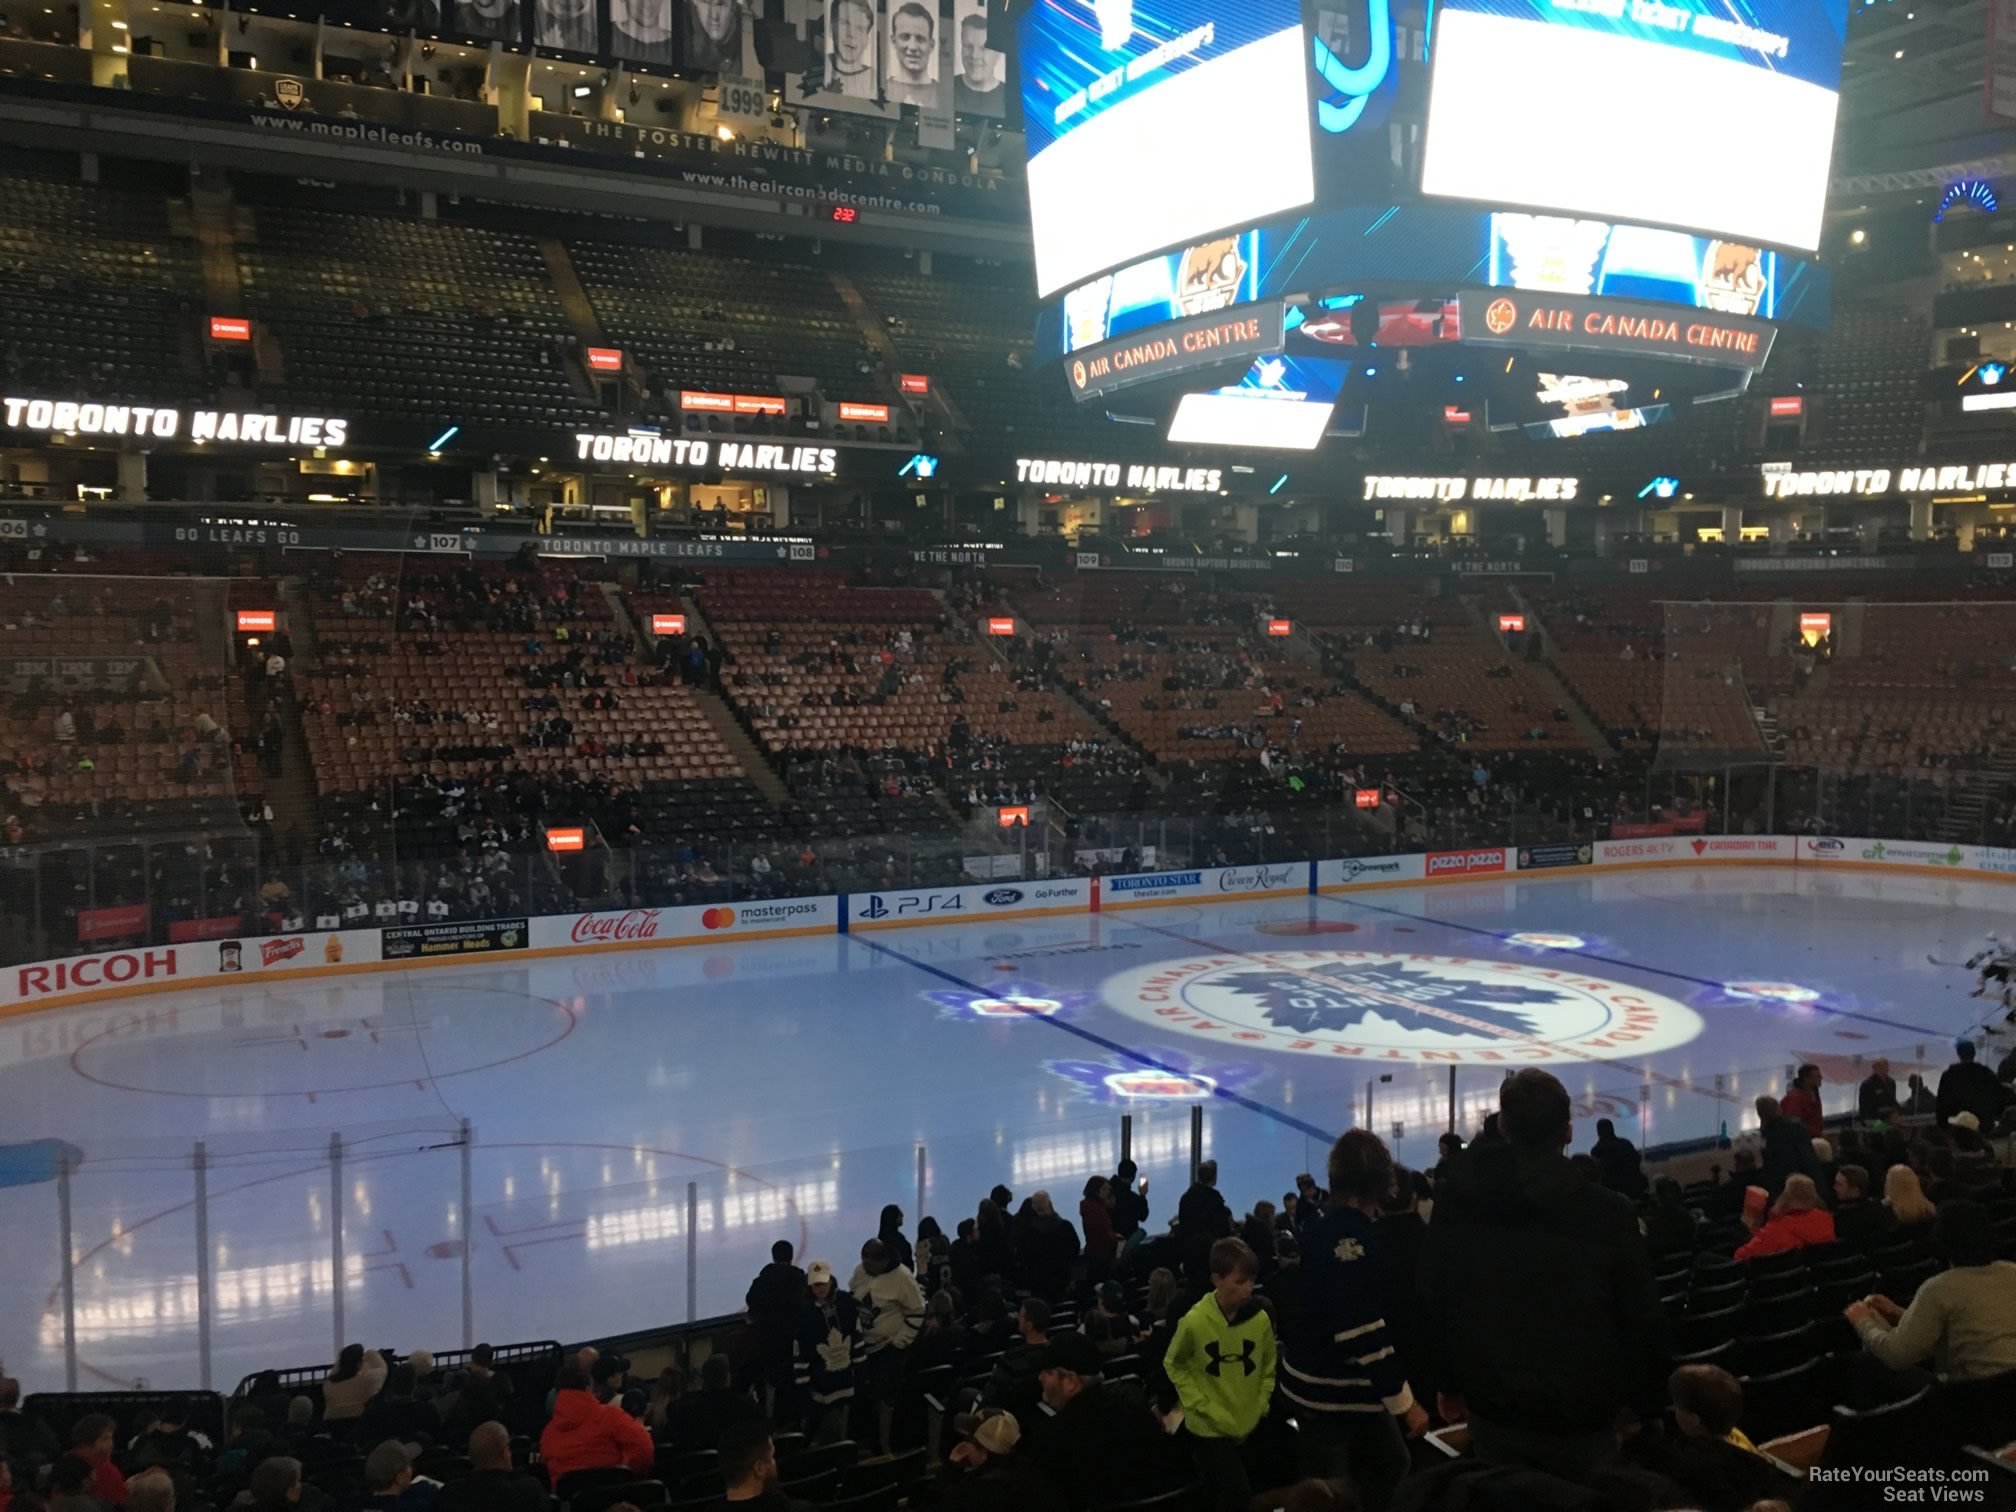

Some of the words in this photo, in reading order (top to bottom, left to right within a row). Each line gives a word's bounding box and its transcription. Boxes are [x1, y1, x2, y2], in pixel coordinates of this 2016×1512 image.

[721, 86, 763, 117] 1999
[250, 112, 482, 155] www.mapleleafs.com
[582, 120, 624, 139] THE
[639, 128, 721, 153] FOSTER
[735, 142, 813, 165] HEWITT
[826, 156, 889, 176] MEDIA
[903, 166, 997, 191] GONDOLA
[1528, 308, 1573, 331] AIR
[1584, 312, 1680, 341] CANADA
[1687, 323, 1759, 353] CENTRE
[1090, 358, 1111, 378] AIR
[1114, 338, 1177, 370] CANADA
[1183, 319, 1260, 352] CENTRE
[4, 397, 178, 437] TORONTO
[191, 411, 347, 446] MARLIES
[576, 434, 707, 466] TORONTO
[719, 442, 836, 473] MARLIES
[1016, 459, 1120, 487] TORONTO
[1127, 465, 1222, 492] MARLIES
[1764, 469, 1890, 497] TORONTO
[1364, 476, 1467, 501] TORONTO
[1472, 477, 1578, 500] MARLIES
[176, 528, 198, 541] GO
[210, 529, 267, 544] LEAFS
[277, 532, 299, 545] GO
[432, 536, 459, 550] 107
[542, 539, 612, 554] TORONTO
[619, 541, 667, 556] MAPLE
[678, 543, 723, 557] LEAFS
[791, 546, 813, 559] 108
[914, 551, 928, 562] WE
[930, 551, 948, 563] THE
[951, 551, 985, 564] NORTH
[1079, 554, 1098, 565] 109
[1162, 557, 1194, 567] TORONTO
[1197, 558, 1228, 569] RAPTORS
[1230, 559, 1272, 570] BASKETBALL
[1488, 562, 1520, 573] NORTH
[1604, 845, 1643, 857] ROGERS
[1646, 844, 1659, 855] 4K
[1660, 842, 1675, 854] TV
[1709, 840, 1755, 851] CANADIAN
[1758, 841, 1777, 851] TIRE
[1359, 861, 1399, 873] Greenpark
[1430, 855, 1465, 874] pizza
[1467, 852, 1502, 870] pizza
[1115, 876, 1167, 890] TORONTO
[1170, 873, 1198, 885] STAR
[1219, 867, 1254, 891] Crown
[1253, 865, 1294, 890] Royal
[898, 893, 963, 914] PS4
[991, 889, 1018, 905] Ford
[1035, 889, 1048, 899] Go
[1048, 887, 1078, 898] Further
[1134, 888, 1177, 899] thestar.com
[741, 903, 817, 919] masterpass
[386, 929, 422, 940] CENTRAL
[424, 926, 457, 936] ONTARIO
[459, 923, 495, 934] BUILDING
[497, 920, 526, 931] TRADES
[571, 908, 663, 943] Coca-Cola
[421, 942, 459, 953] Hammer
[463, 938, 490, 949] Heads
[18, 949, 178, 998] RICOH
[1138, 958, 1236, 1003] CANADA
[1267, 971, 1391, 991] LEFS
[1532, 970, 1612, 992] AIR
[1154, 1006, 1229, 1032] AIR
[1577, 995, 1660, 1049] CANADA
[1288, 1038, 1554, 1062] CENTRE
